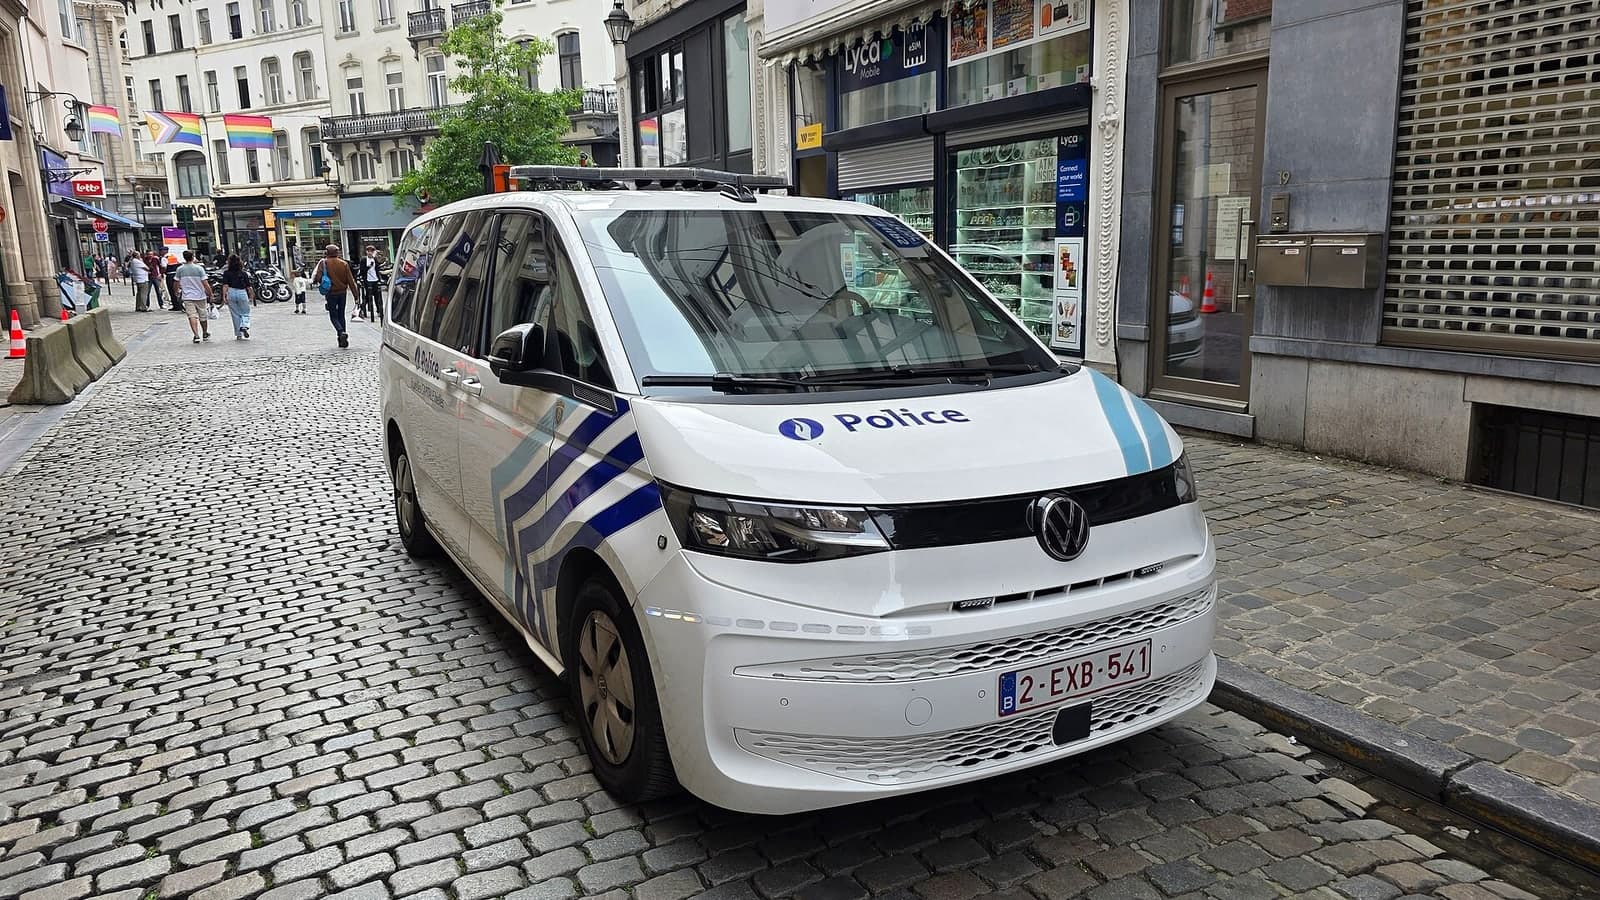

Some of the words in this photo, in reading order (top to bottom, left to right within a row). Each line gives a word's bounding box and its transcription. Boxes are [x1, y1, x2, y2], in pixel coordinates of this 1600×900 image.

[845, 41, 880, 75] Lyca
[860, 66, 880, 80] Mobile
[1060, 135, 1078, 147] Lyca
[1039, 159, 1054, 170] ATM
[1037, 169, 1056, 181] INSIDE
[1278, 171, 1290, 185] 19
[420, 350, 440, 380] Police
[833, 408, 971, 432] Police
[1019, 646, 1147, 704] 2-EXB-541
[1003, 697, 1013, 710] B
